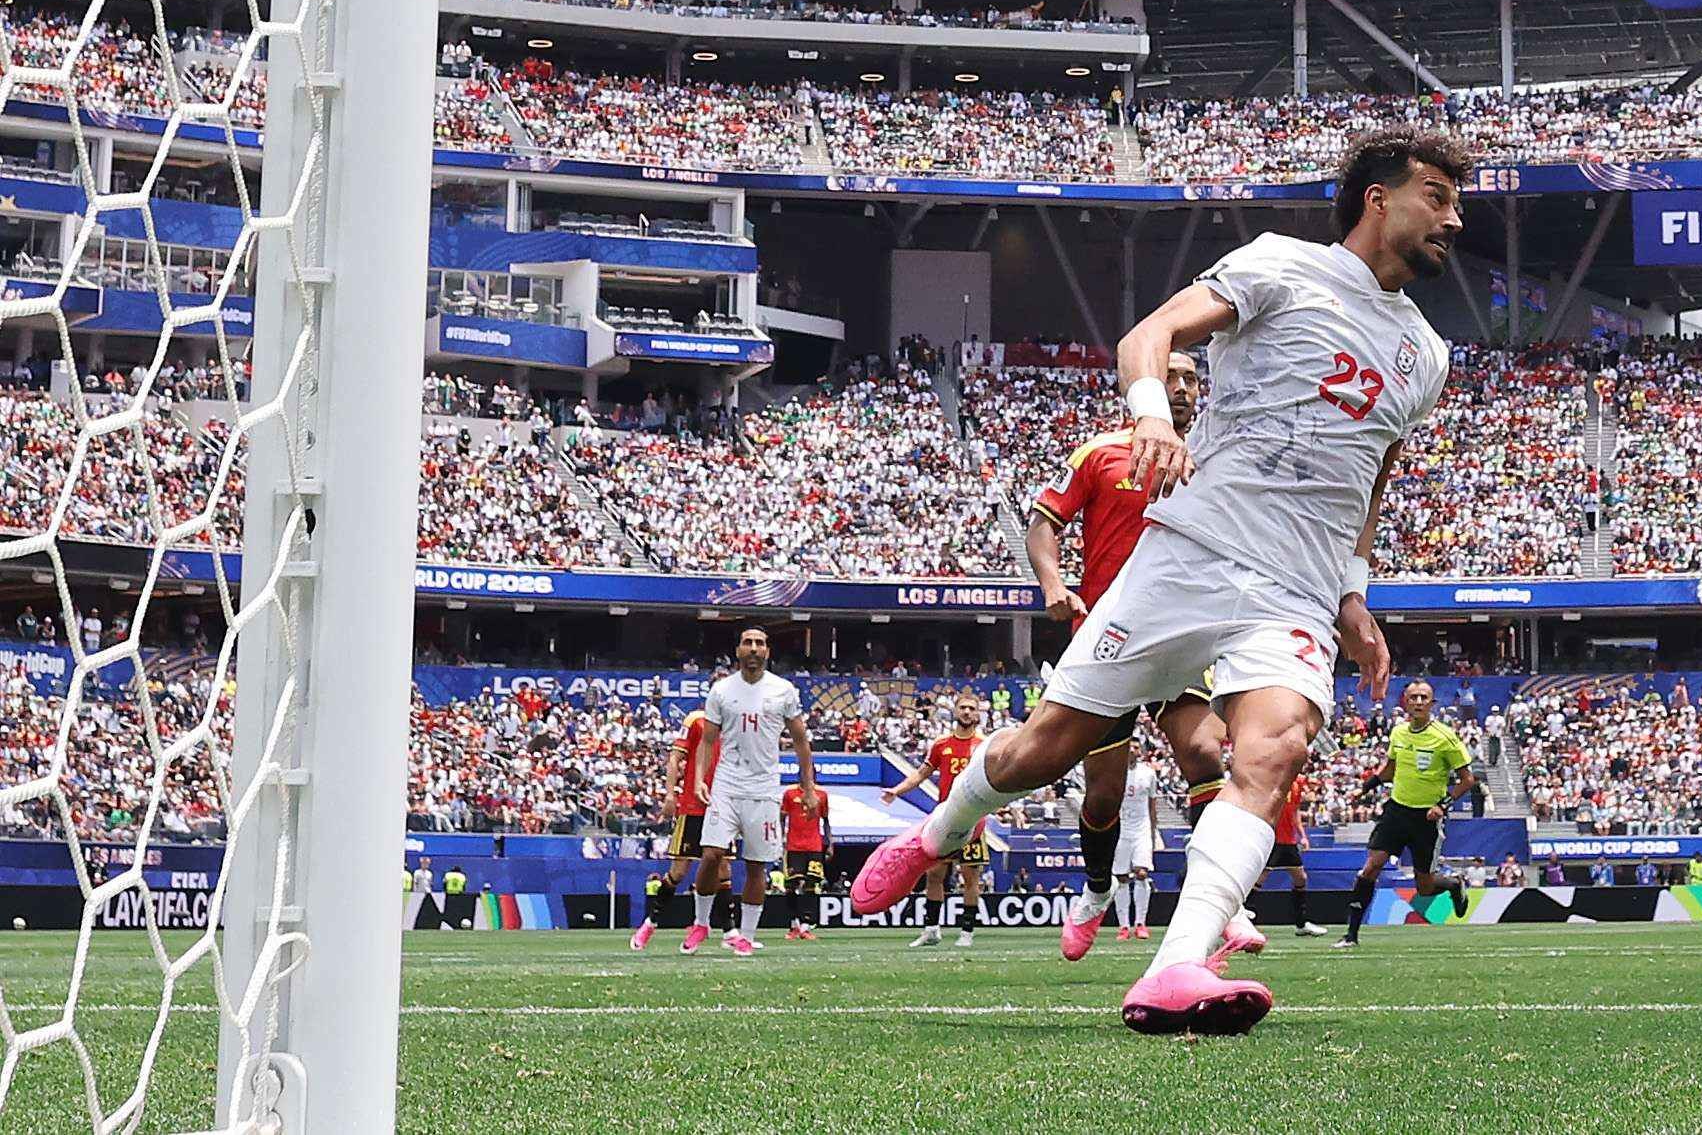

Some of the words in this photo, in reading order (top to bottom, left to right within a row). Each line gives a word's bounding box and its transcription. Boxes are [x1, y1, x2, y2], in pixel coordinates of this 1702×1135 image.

[642, 167, 666, 180] LOS
[667, 169, 719, 183] ANGELES
[1318, 351, 1385, 421] 23
[415, 569, 450, 588] RLD
[450, 571, 487, 591] CUP
[487, 574, 553, 594] 2026
[897, 588, 938, 605] LOS
[942, 588, 1034, 605] ANGELES
[493, 676, 556, 695] LOS
[742, 712, 759, 733] 14
[962, 843, 982, 861] 23
[1531, 842, 1553, 855] IFA
[1553, 842, 1603, 855] WORLD
[1603, 841, 1631, 855] CUP
